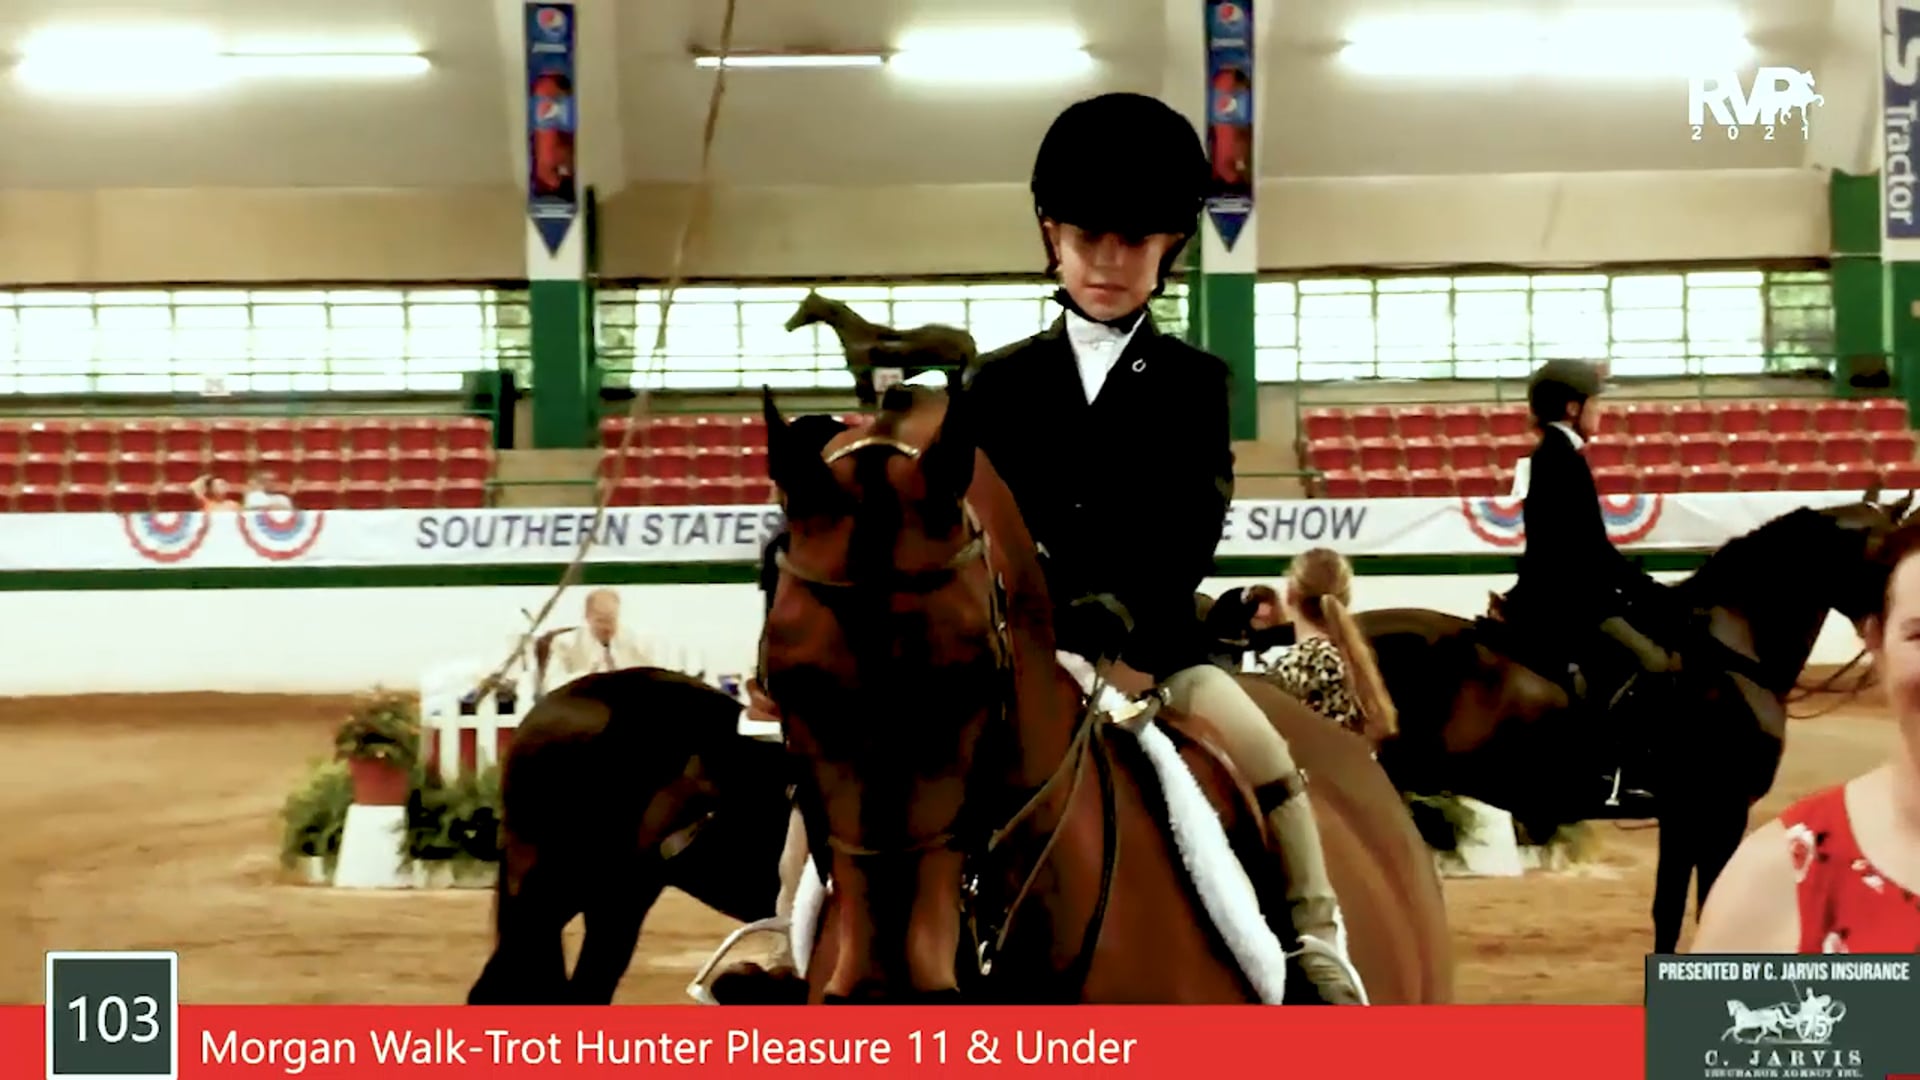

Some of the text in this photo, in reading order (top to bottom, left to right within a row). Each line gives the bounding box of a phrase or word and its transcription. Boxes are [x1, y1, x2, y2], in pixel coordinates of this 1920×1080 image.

[1886, 100, 1918, 225] Tractor
[416, 511, 784, 549] SOUTHERN STATES
[1247, 506, 1367, 541] SHOW
